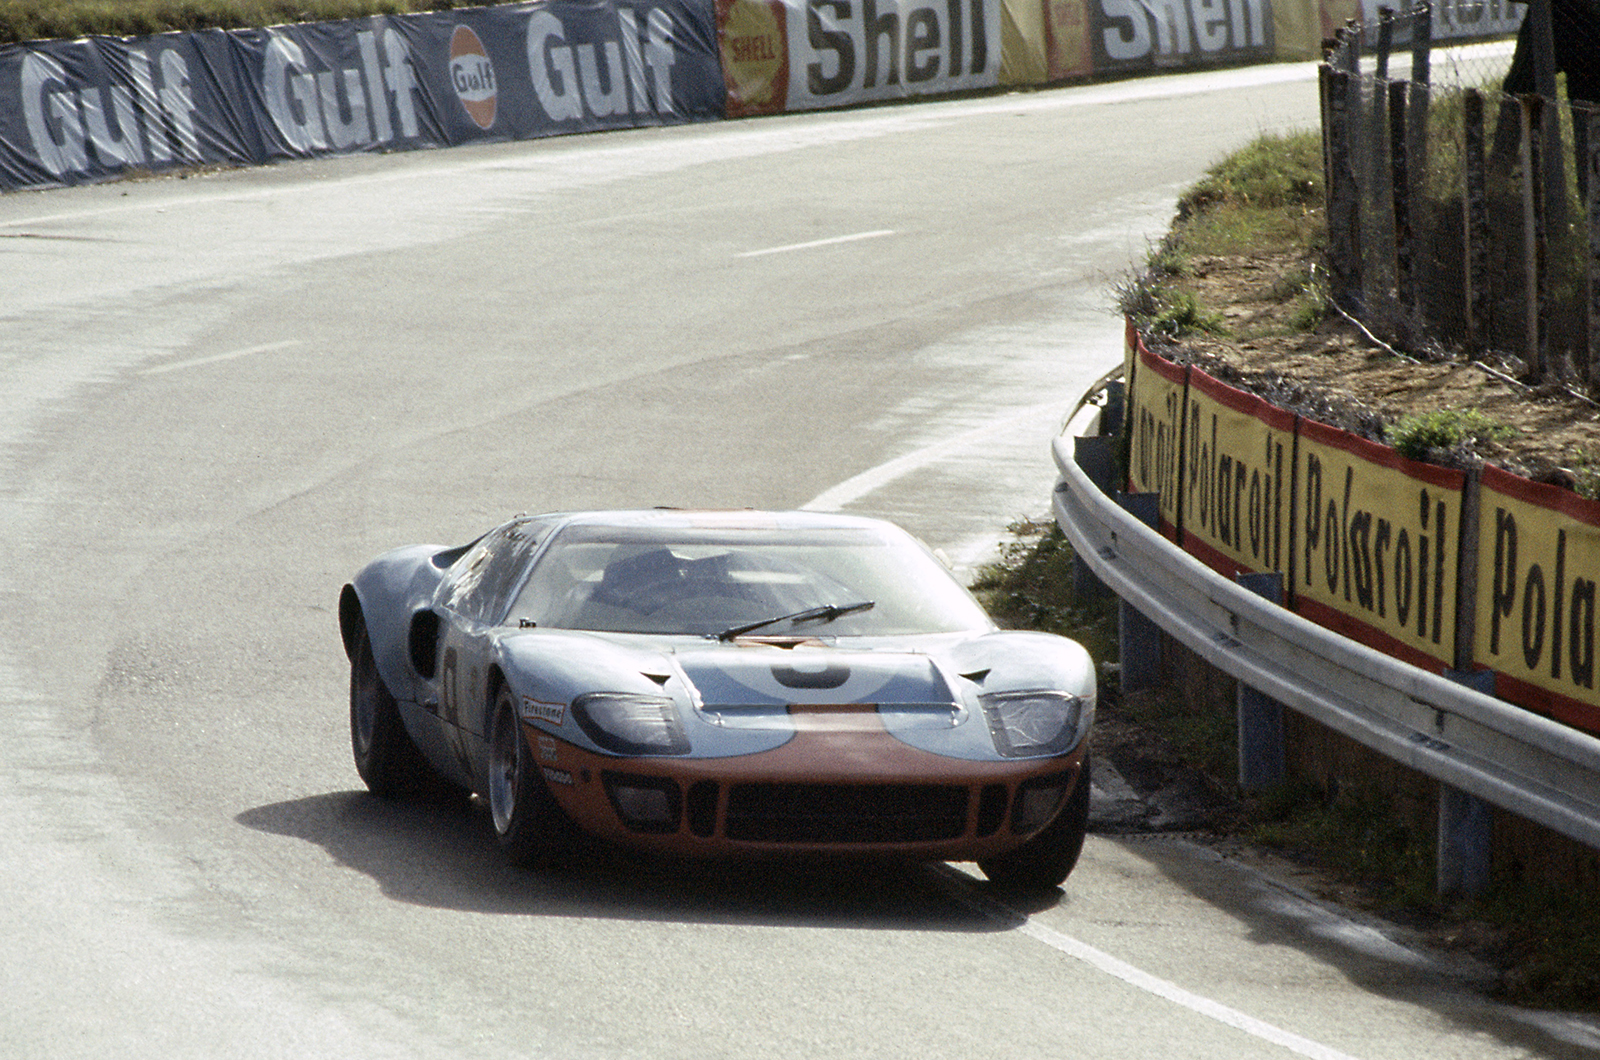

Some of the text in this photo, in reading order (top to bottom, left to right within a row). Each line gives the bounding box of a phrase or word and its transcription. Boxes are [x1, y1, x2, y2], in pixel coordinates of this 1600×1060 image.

[263, 30, 419, 151] Gulf
[452, 61, 493, 92] Gulf
[527, 8, 675, 121] Gulf
[732, 35, 775, 62] SHELL
[806, 0, 987, 95] Shell
[21, 48, 201, 176] Gulf
[1188, 399, 1282, 574] Polaroil
[1305, 452, 1446, 645] Polaroil
